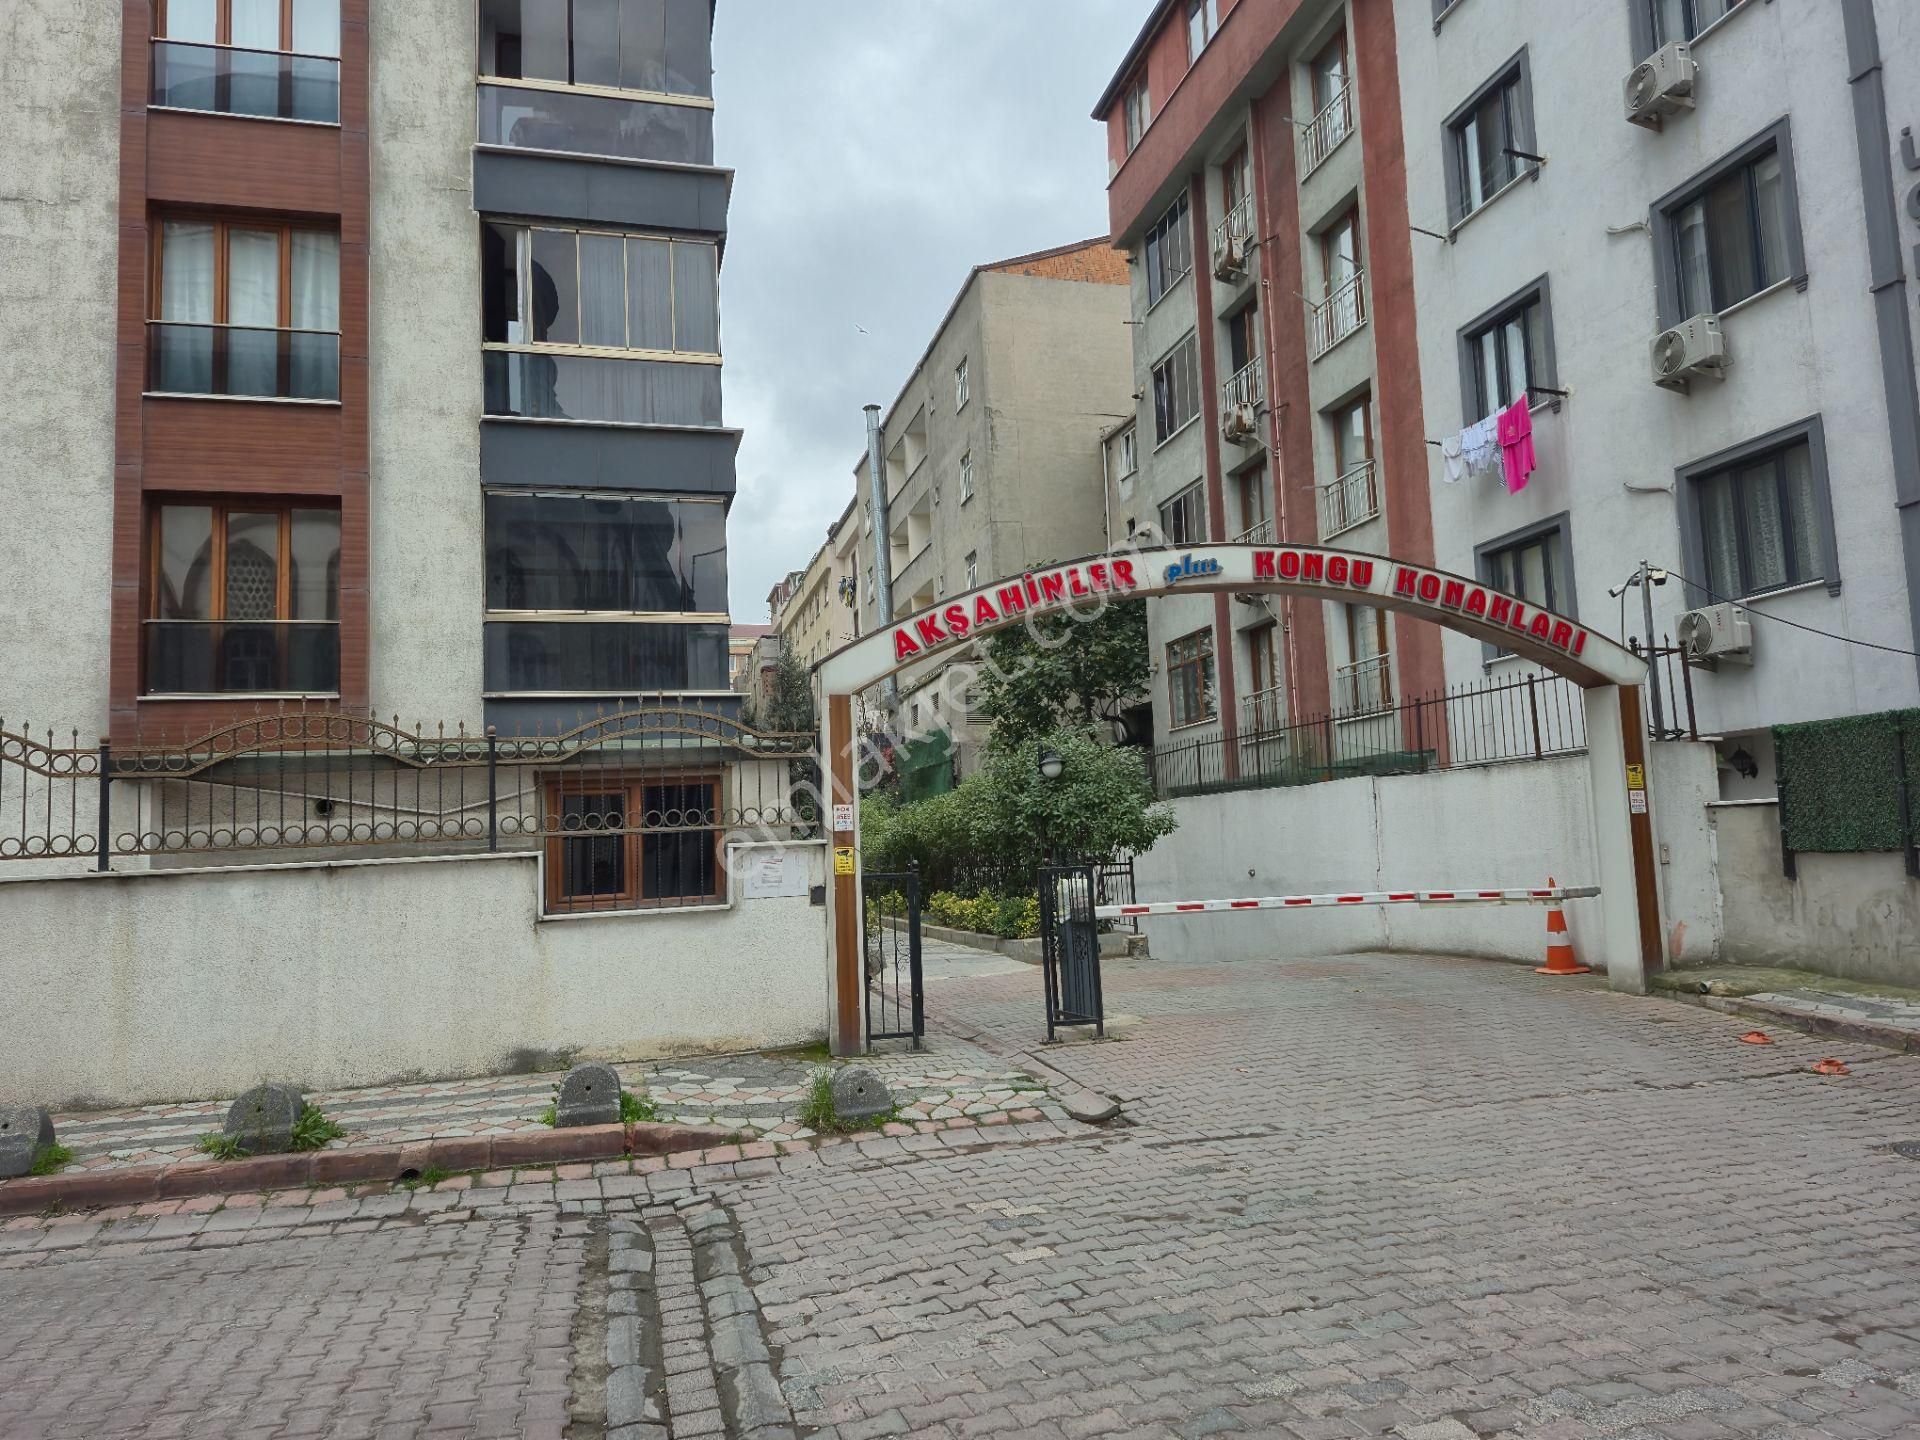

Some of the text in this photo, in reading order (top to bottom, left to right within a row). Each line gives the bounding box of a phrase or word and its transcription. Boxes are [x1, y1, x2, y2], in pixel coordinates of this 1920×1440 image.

[893, 550, 1588, 662] AKŞAHİNLER plus KONGU KONAKLARI
